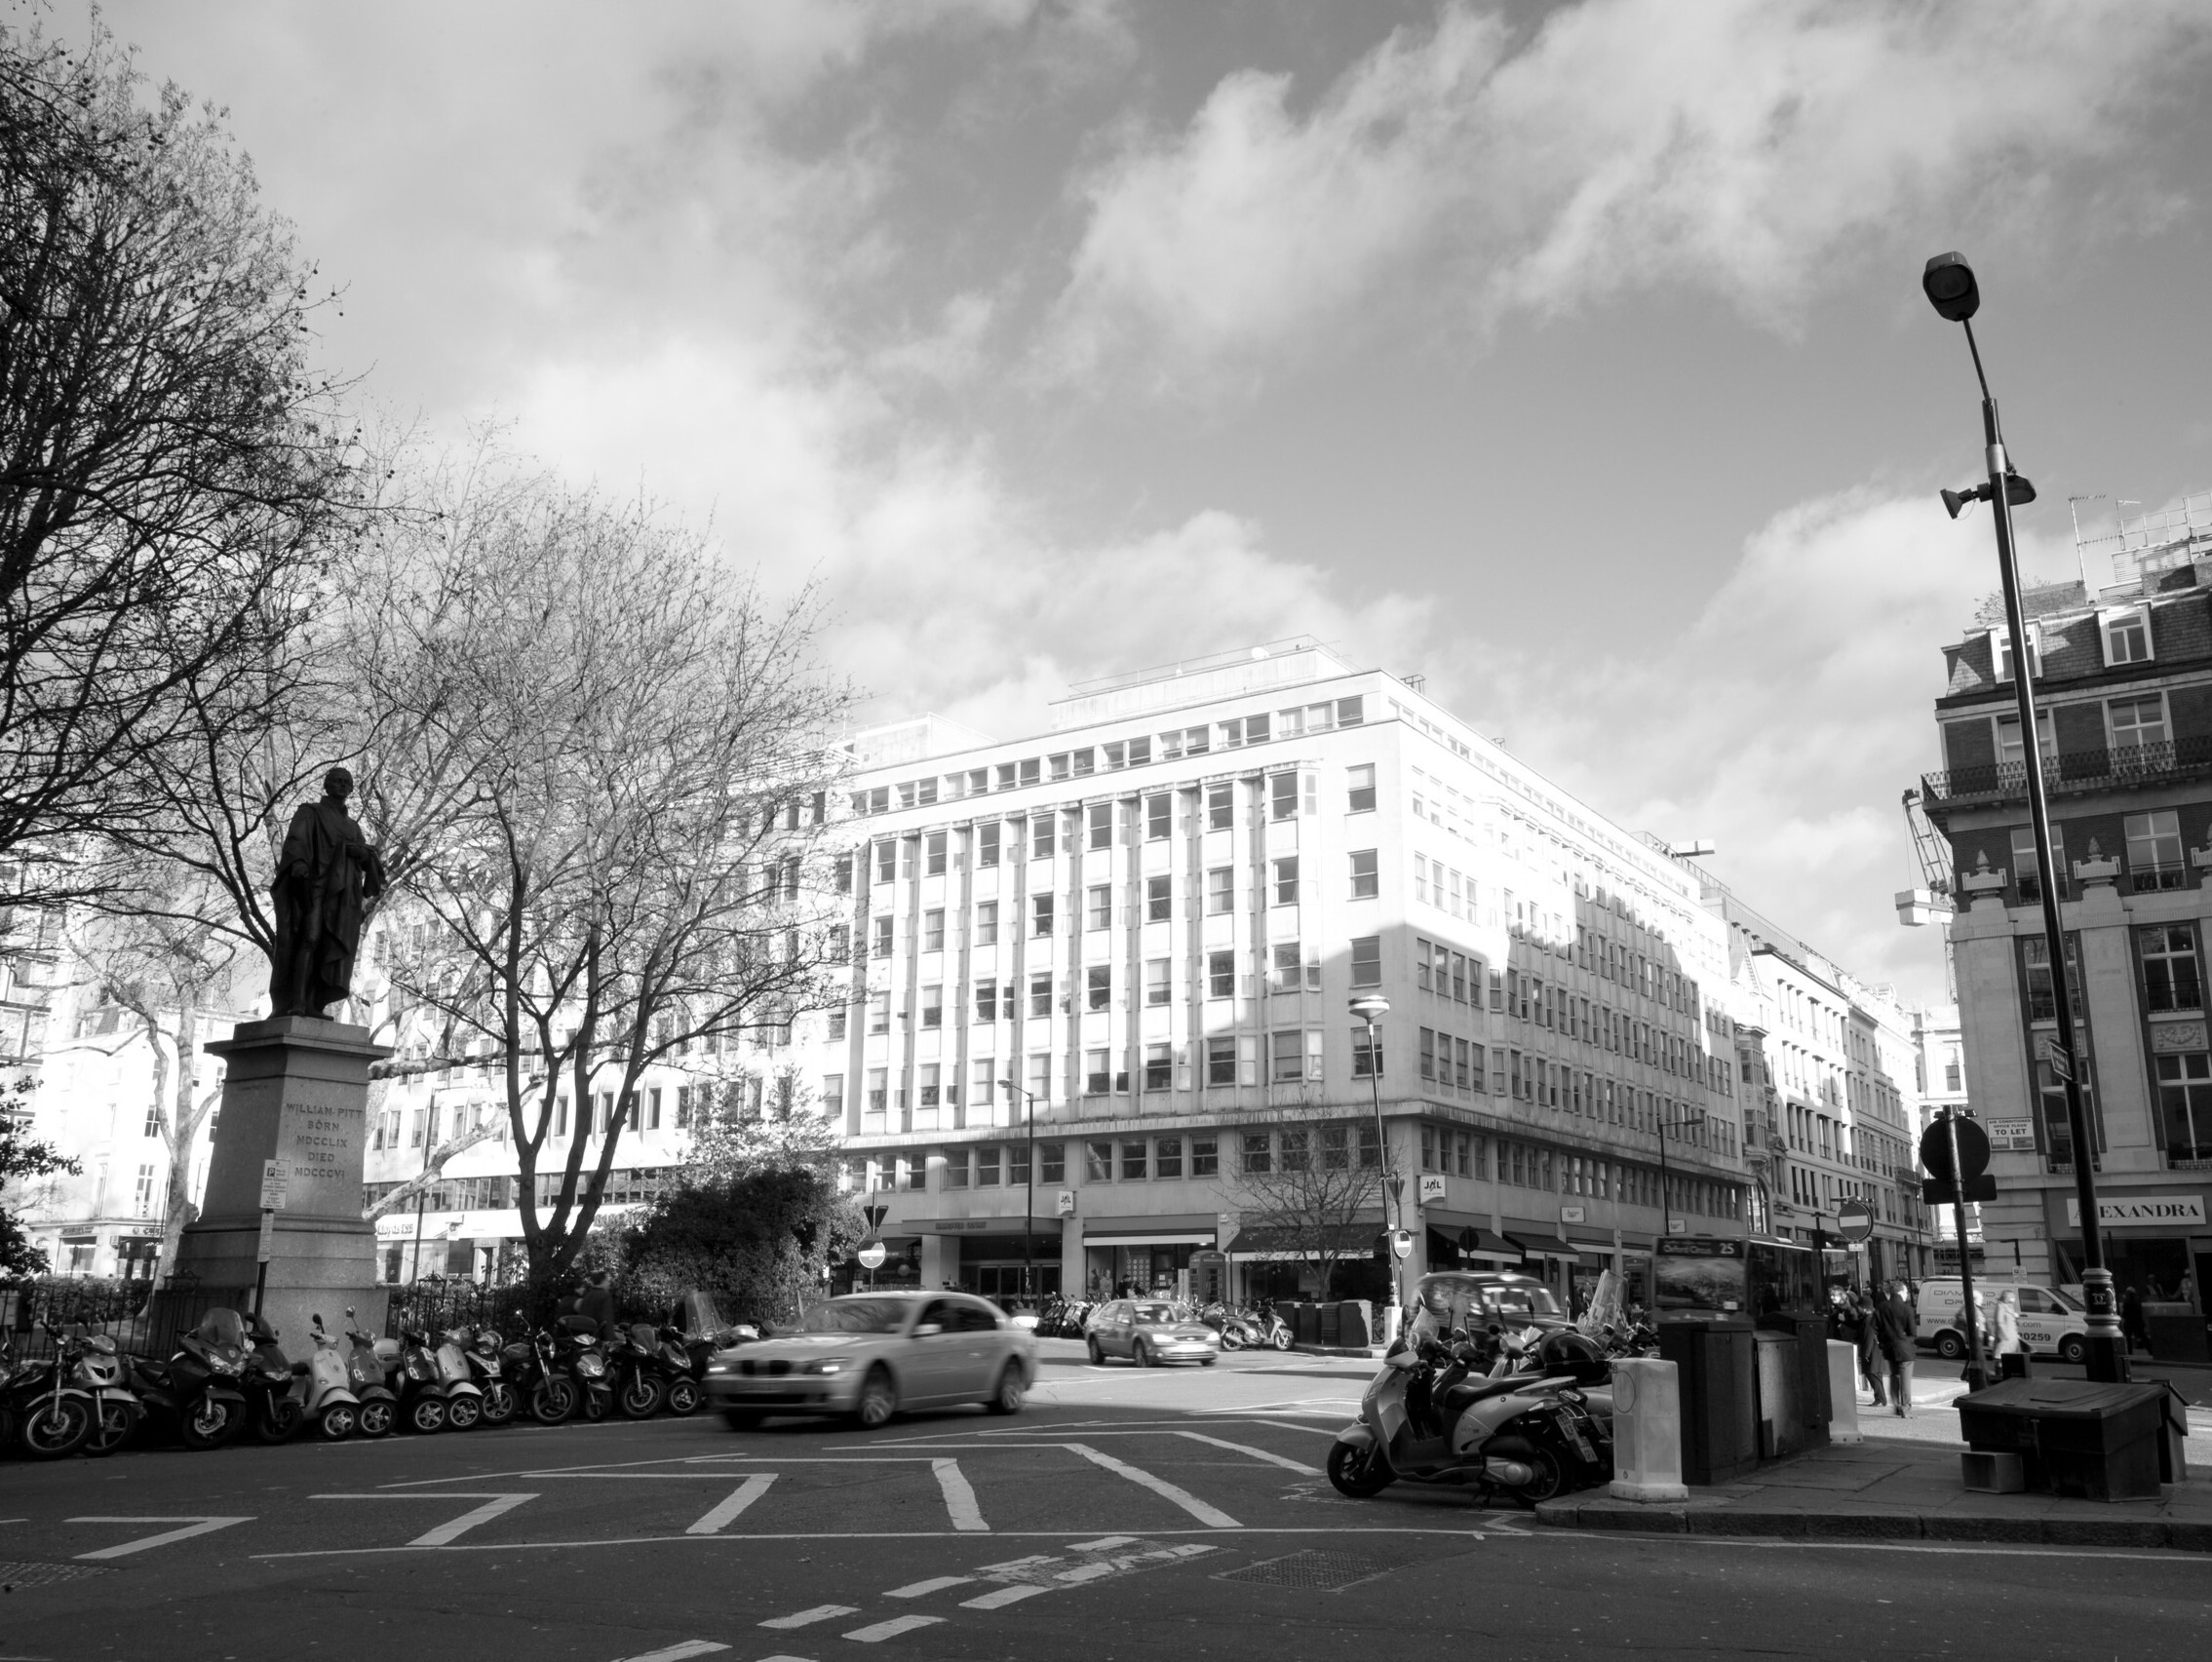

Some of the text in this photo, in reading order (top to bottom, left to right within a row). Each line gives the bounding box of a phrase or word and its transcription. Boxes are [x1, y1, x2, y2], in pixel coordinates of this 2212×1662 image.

[337, 1107, 363, 1119] PITT
[307, 1119, 339, 1132] BORN
[296, 1136, 347, 1147] MDCCLIX
[307, 1151, 335, 1163] DIED
[294, 1167, 345, 1179] MDCCCVI
[1424, 1179, 1442, 1192] JAL
[2075, 1204, 2199, 1218] AEXANDRA
[1720, 1243, 1734, 1255] 25
[1933, 1290, 1996, 1298] DIAMD
